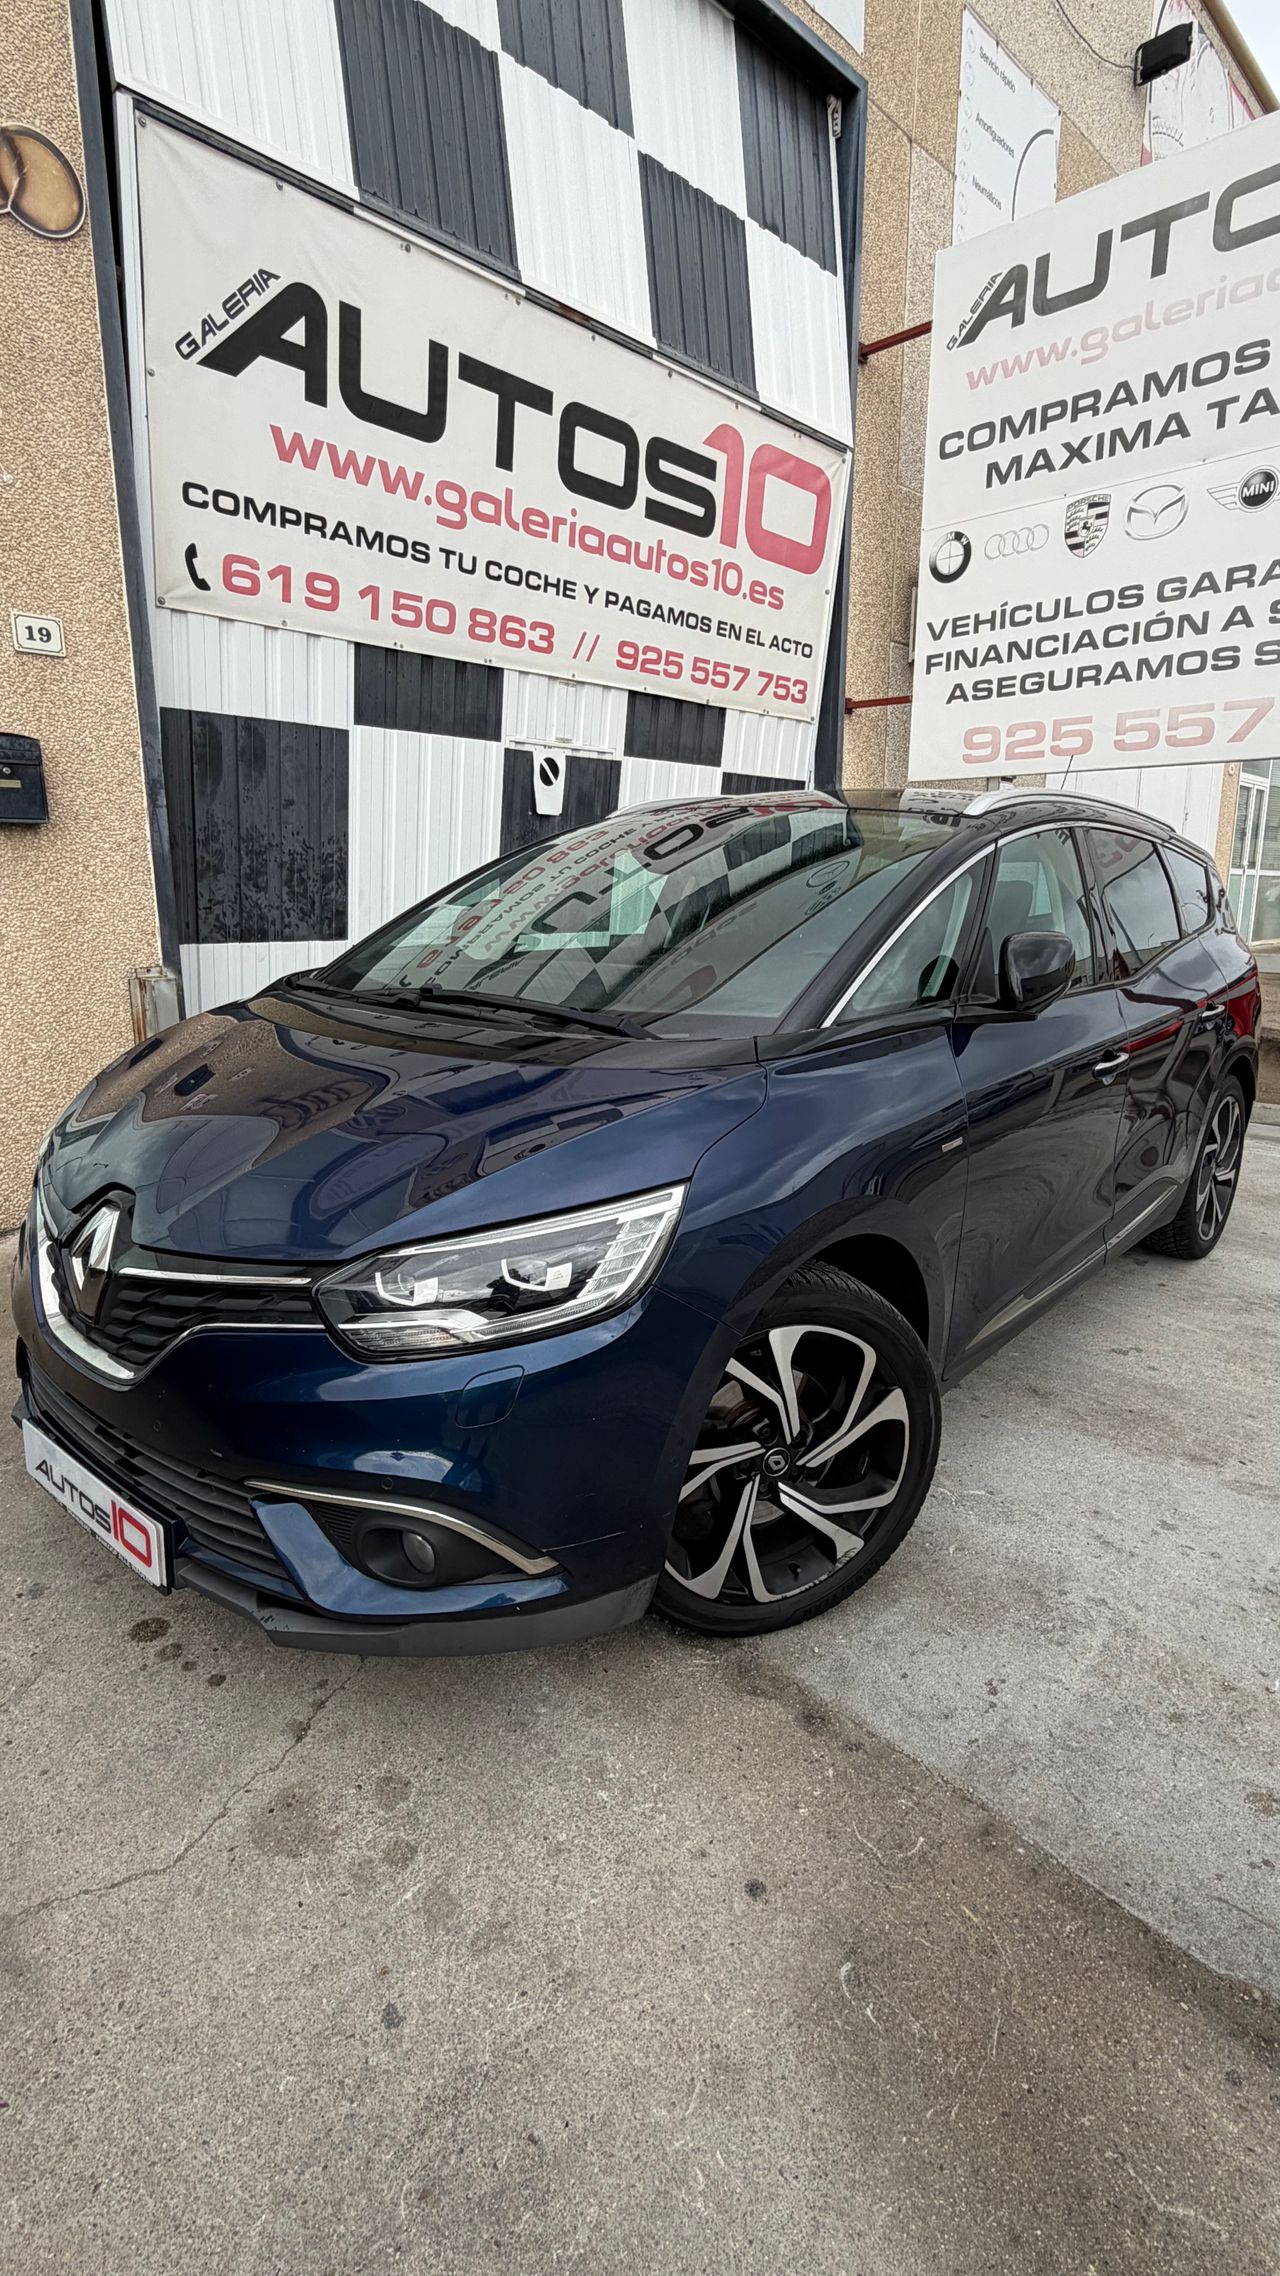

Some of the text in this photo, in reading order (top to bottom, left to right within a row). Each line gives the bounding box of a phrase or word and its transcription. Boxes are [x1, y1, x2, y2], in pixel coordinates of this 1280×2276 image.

[979, 46, 1000, 76] Servicio
[975, 112, 1015, 159] Amortiguadores
[175, 268, 281, 361] GALERIA
[946, 272, 1003, 351] GALERIA
[196, 282, 832, 575] AUTOS10
[939, 339, 1271, 460] COMPRAMOS
[985, 387, 1280, 489] MAXIMA TA
[269, 424, 785, 611] www.galeriaautos10.es
[1067, 494, 1110, 511] PORSCHE
[1242, 480, 1275, 498] MINI
[182, 481, 814, 659] COMPRAMOS TU COCHE Y PAGAMOS EN EL ACTO
[25, 625, 52, 643] 19
[222, 553, 341, 612] 619
[358, 584, 457, 636] 150
[467, 607, 556, 655] 863
[615, 640, 684, 680] 925
[690, 658, 751, 693] 557
[756, 671, 809, 705] 753
[925, 610, 1210, 675] FINANCIACIÓN
[1220, 605, 1255, 632] A
[926, 583, 1145, 642] VEHÍCULOS
[946, 645, 1241, 705] ASEGURAMOS
[962, 697, 1276, 764] 925 557
[35, 1459, 153, 1568] AUTOS10
